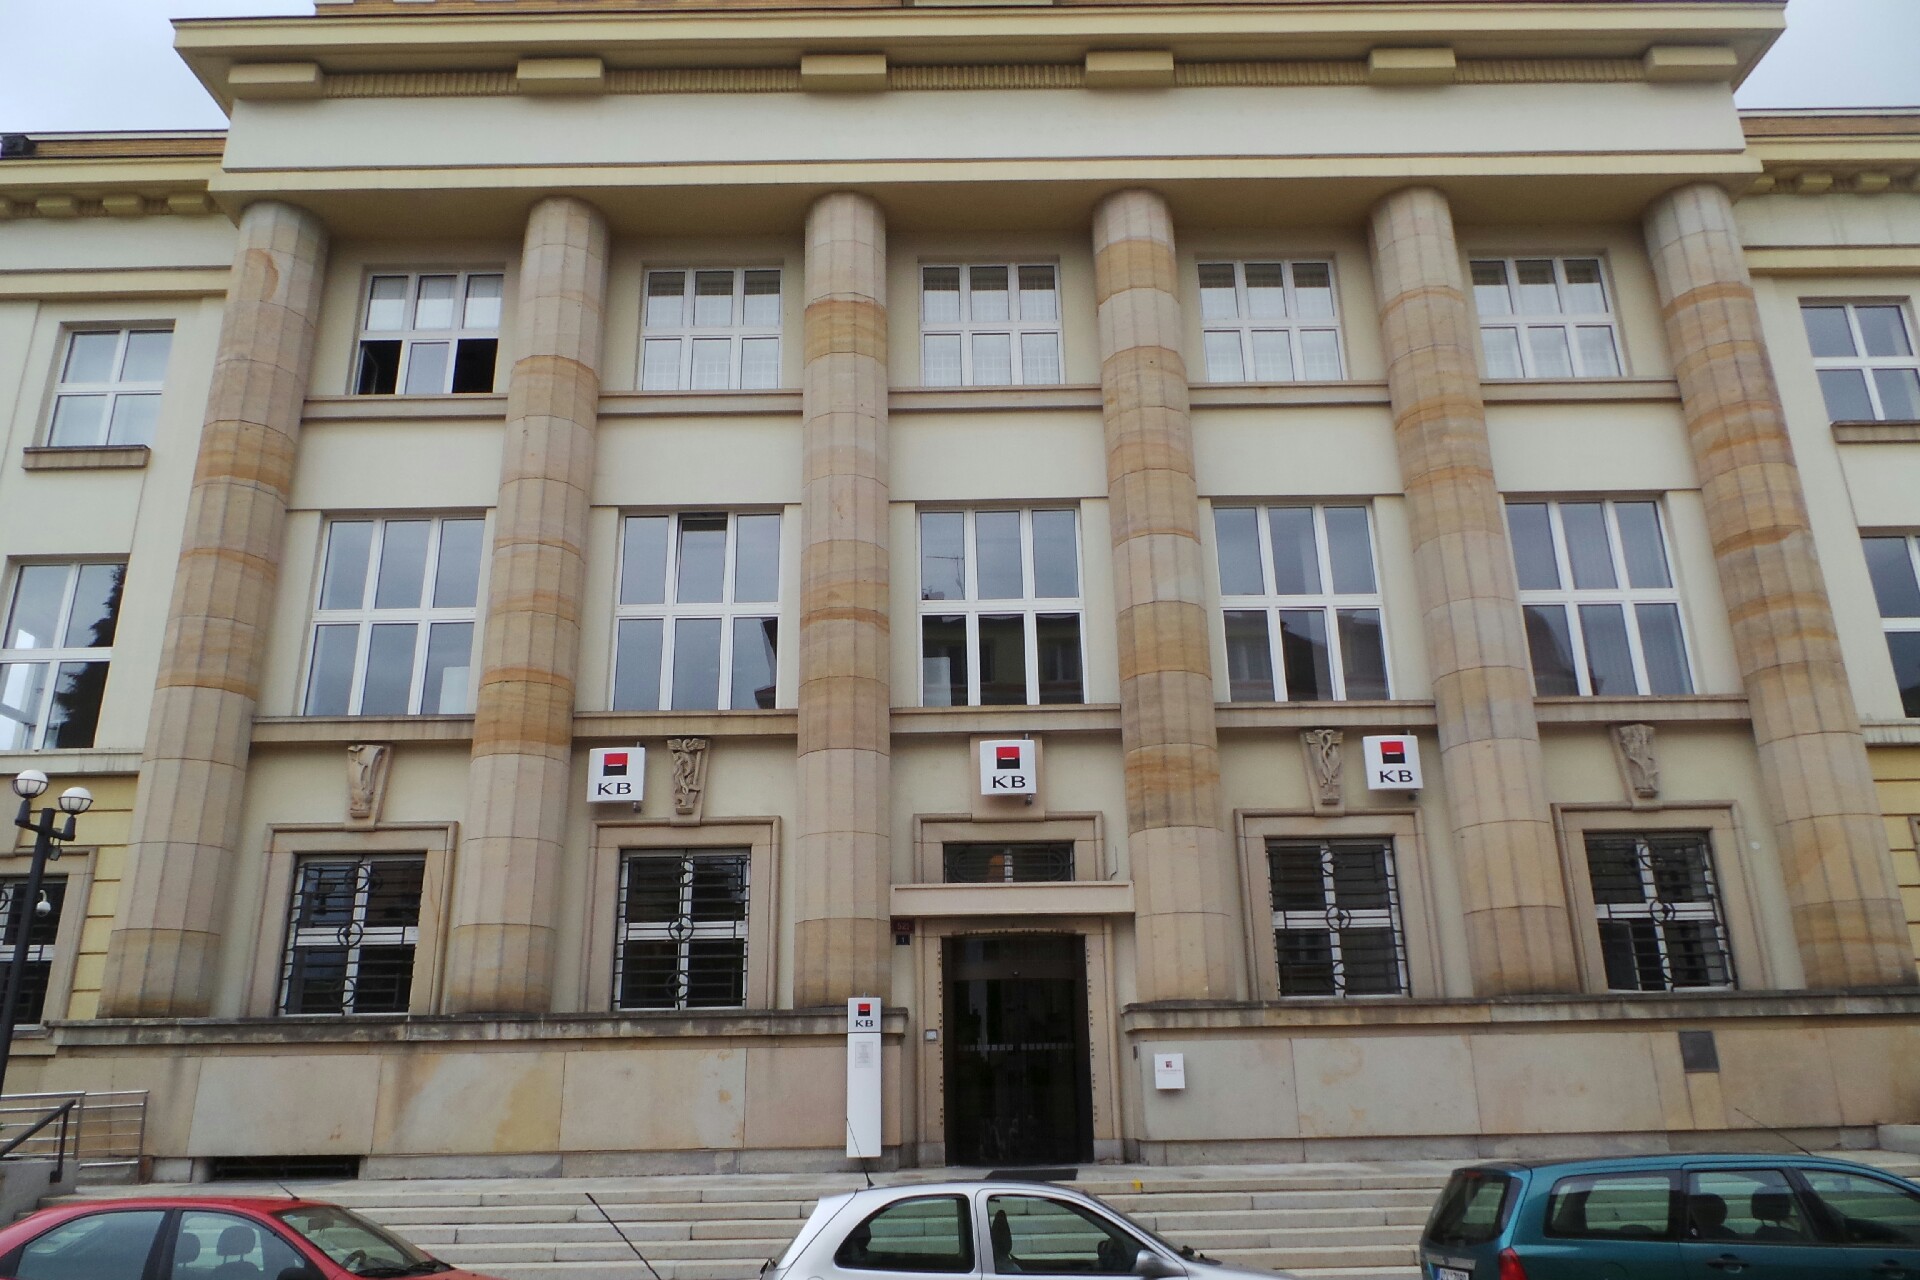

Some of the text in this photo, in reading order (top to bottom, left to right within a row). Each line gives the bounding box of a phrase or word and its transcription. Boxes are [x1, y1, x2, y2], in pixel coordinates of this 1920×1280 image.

[992, 775, 1026, 789] KB
[1379, 769, 1414, 783] KB
[597, 782, 632, 796] KB
[855, 1019, 874, 1028] KB
